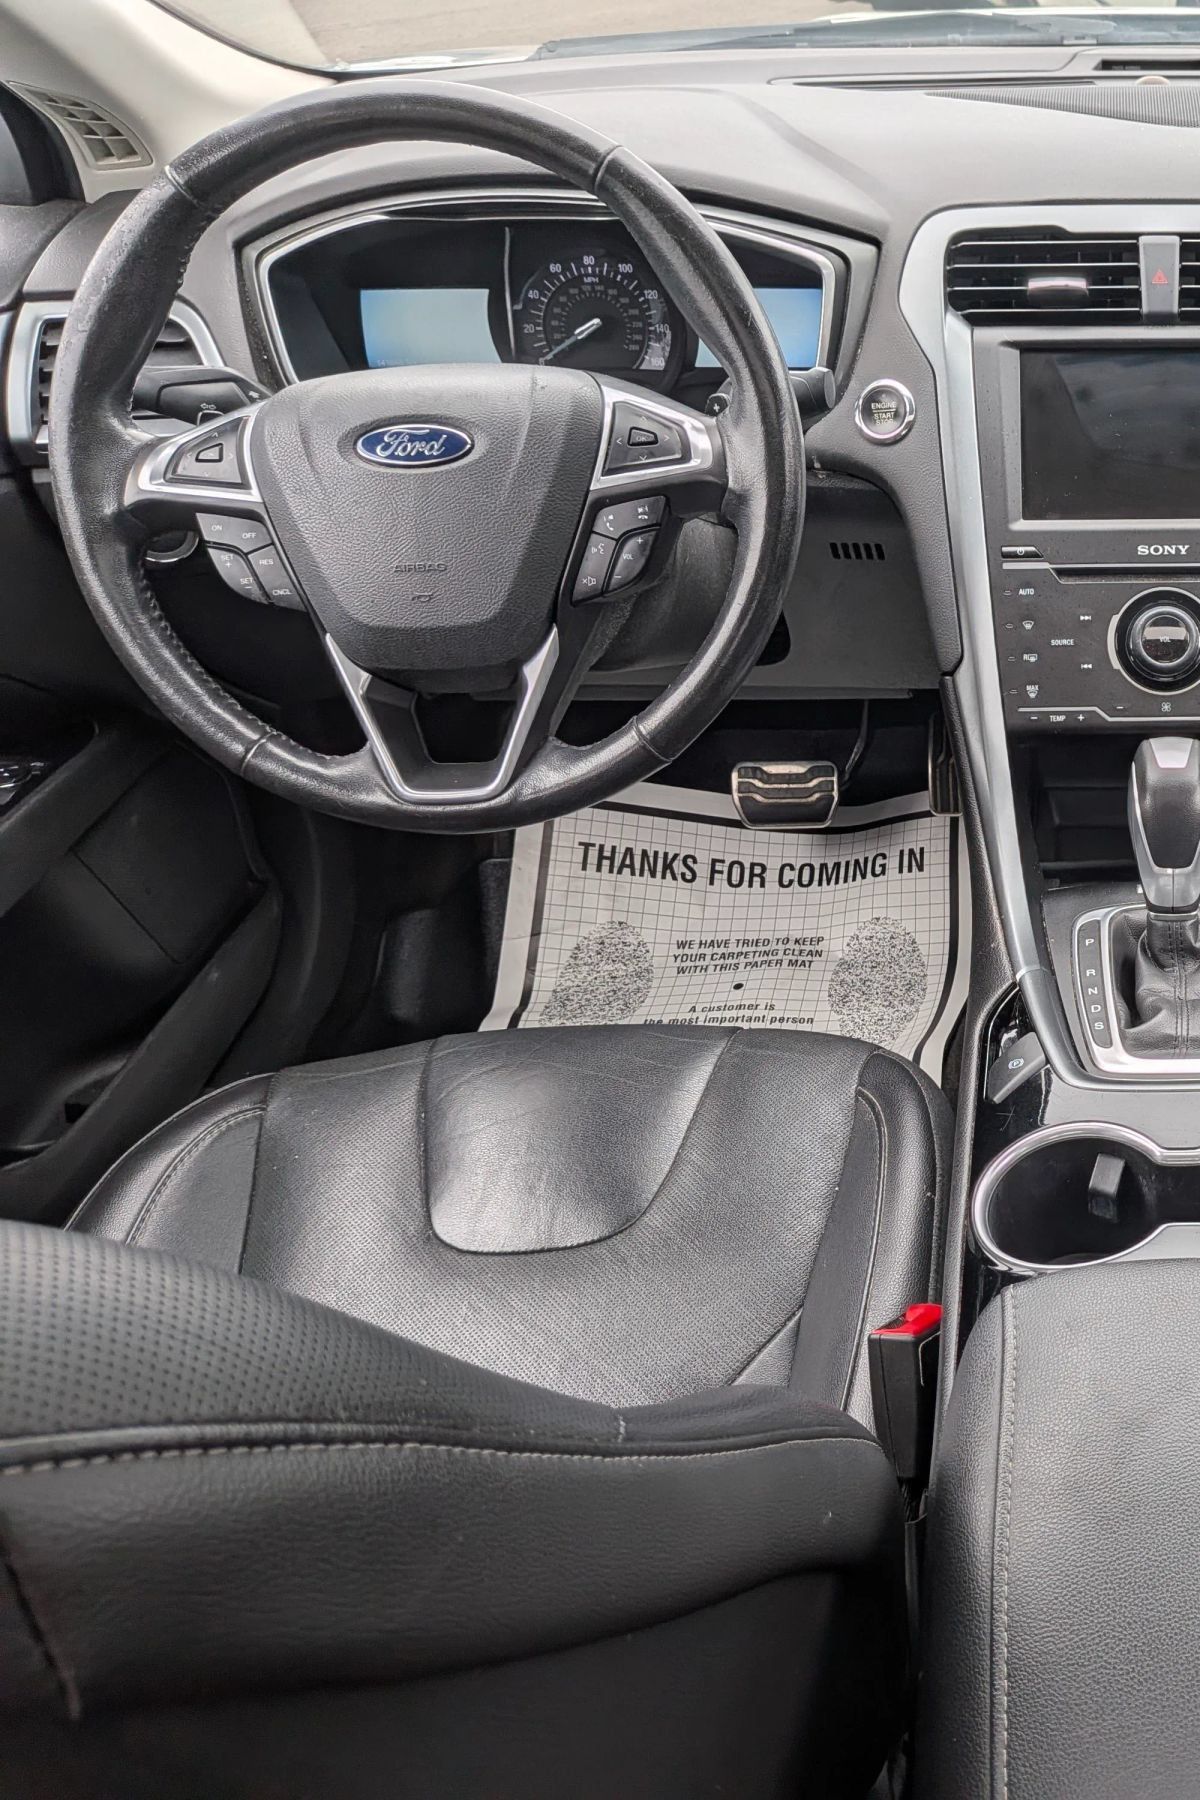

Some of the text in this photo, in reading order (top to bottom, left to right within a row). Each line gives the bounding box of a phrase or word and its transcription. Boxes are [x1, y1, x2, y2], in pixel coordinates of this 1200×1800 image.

[583, 256, 595, 265] 80
[550, 264, 561, 273] 60
[618, 264, 633, 273] 100
[528, 291, 539, 299] 40
[644, 290, 658, 299] 120
[523, 324, 534, 333] 20
[655, 324, 670, 333] 140
[650, 358, 665, 366] 160
[376, 428, 447, 457] Ford
[1137, 545, 1190, 555] SONY
[578, 842, 925, 888] THANKS FOR COMING IN
[676, 936, 824, 950] WE HAVE TRIED TO KEEP
[673, 948, 823, 963] YOUR CARPETING CLEAN
[677, 959, 814, 974] WITH THIS PAPER MAT
[1088, 987, 1098, 995] N
[702, 1004, 760, 1012] customer
[764, 1002, 776, 1011] is
[1091, 1004, 1101, 1012] D
[668, 1016, 699, 1024] most
[704, 1015, 766, 1025] important
[770, 1016, 814, 1025] person
[1094, 1022, 1104, 1030] S
